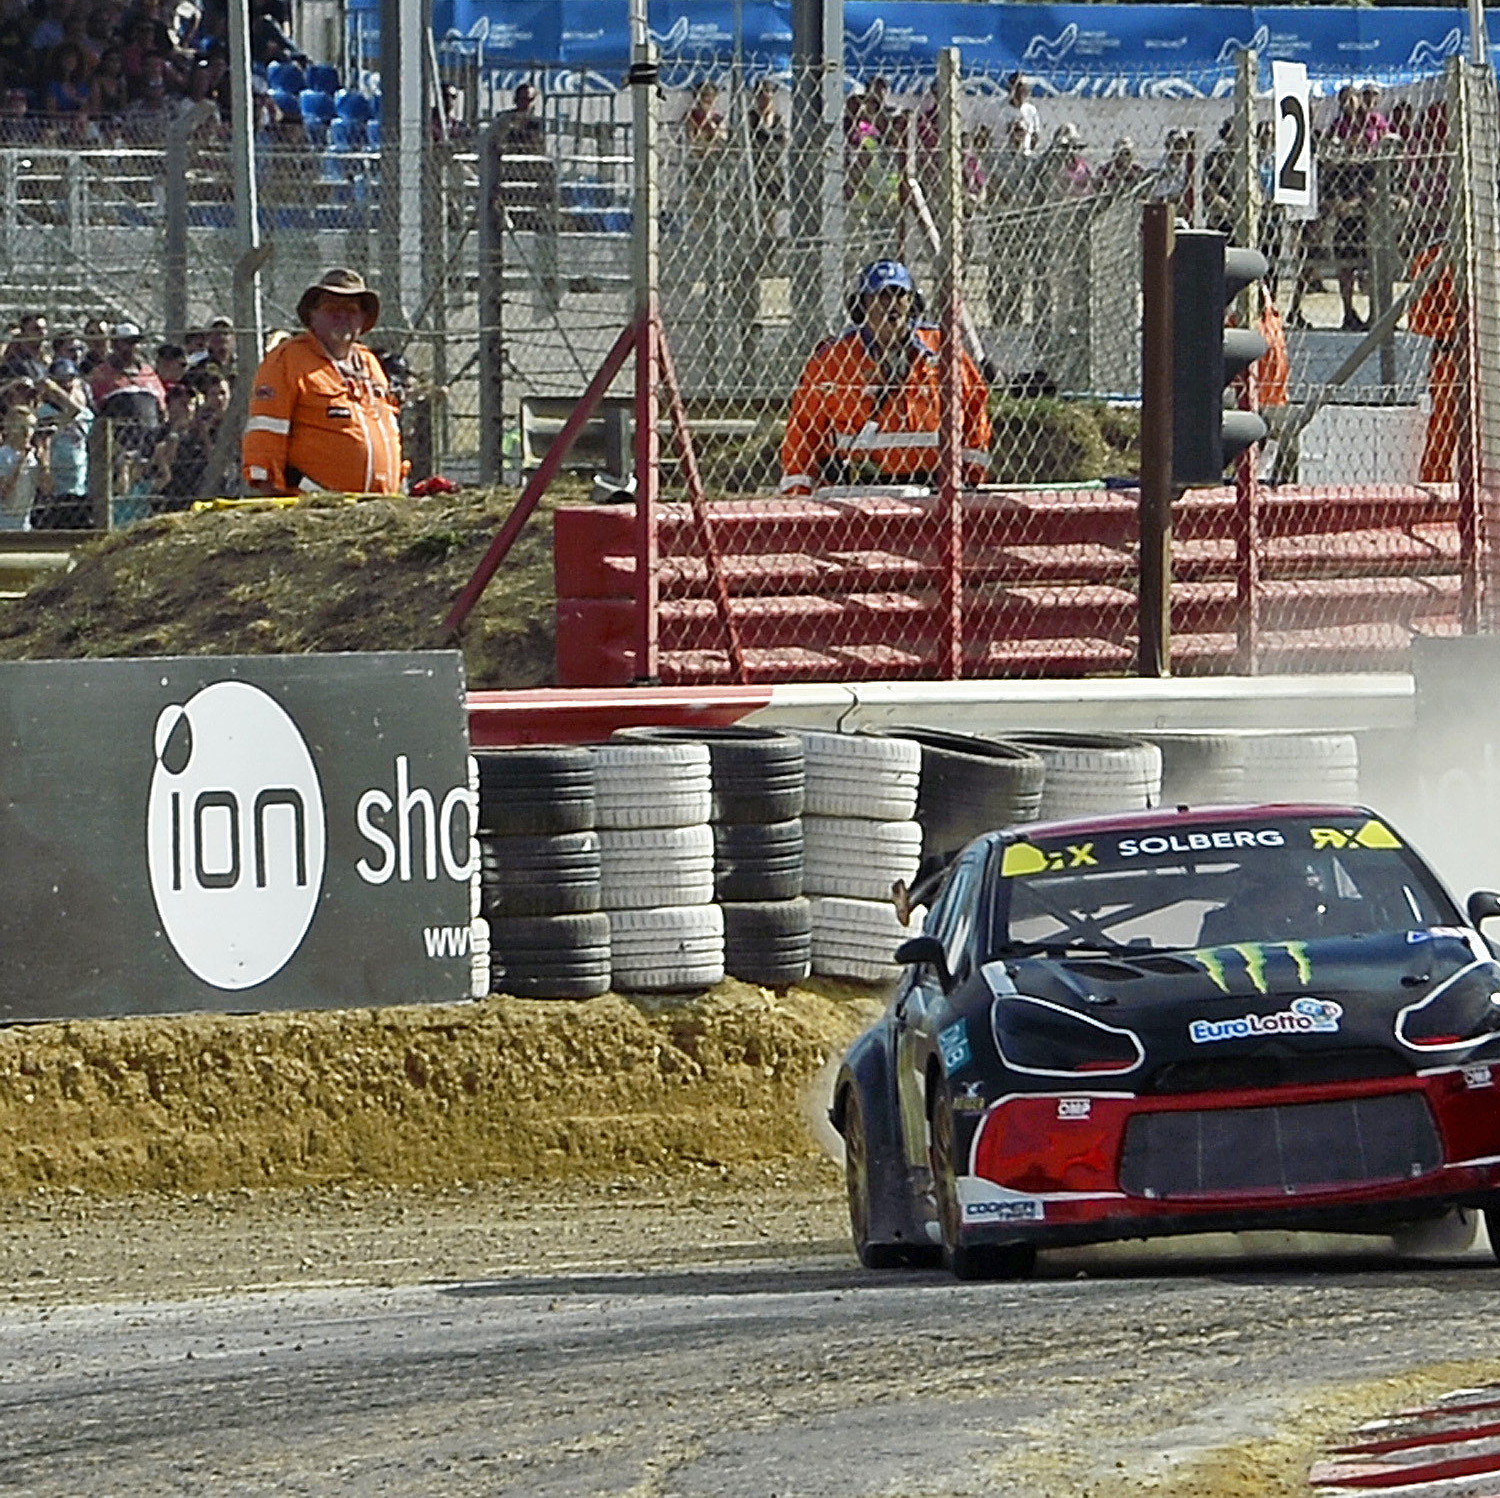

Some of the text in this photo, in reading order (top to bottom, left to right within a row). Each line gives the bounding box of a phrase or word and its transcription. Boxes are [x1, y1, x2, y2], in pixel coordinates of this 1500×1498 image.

[1279, 95, 1306, 192] 2
[1117, 830, 1285, 857] SOLBERG
[1193, 1009, 1312, 1040] EuroLotto
